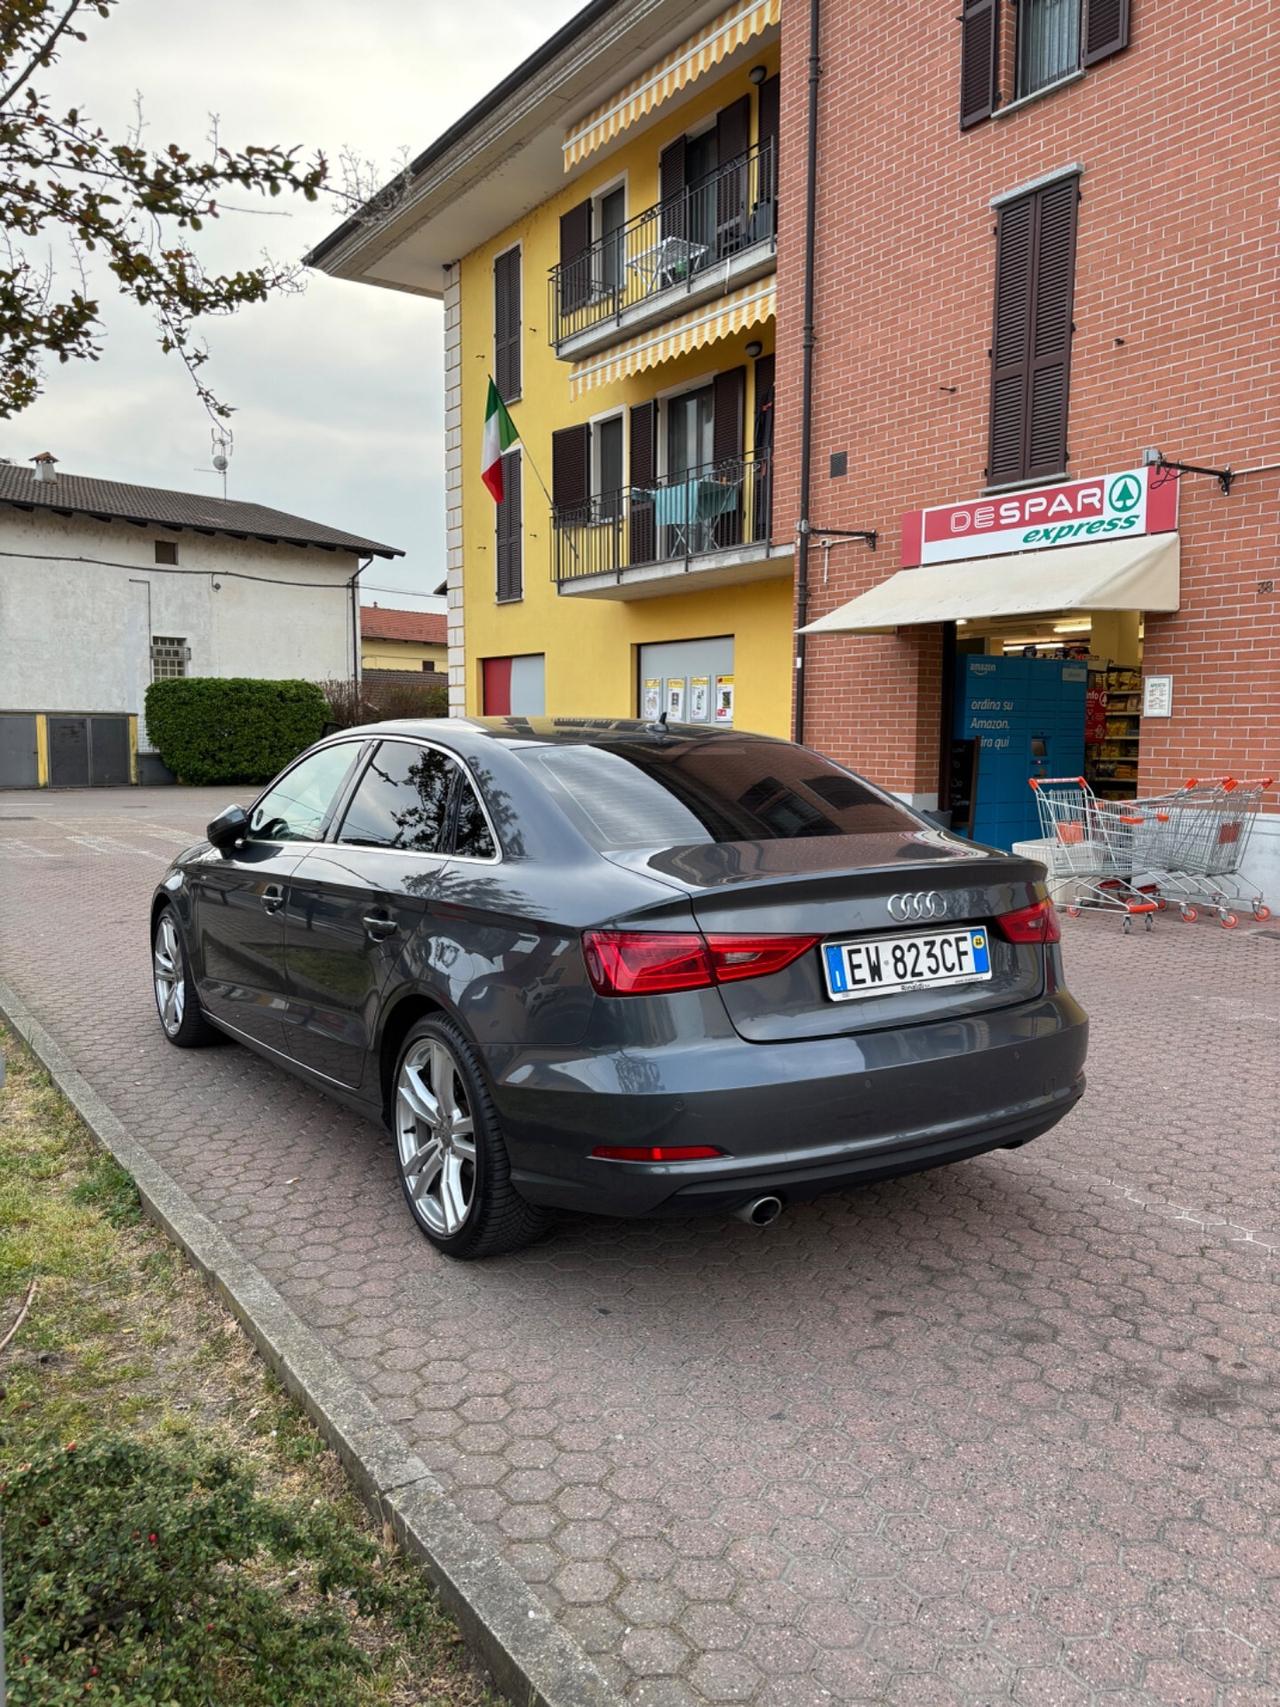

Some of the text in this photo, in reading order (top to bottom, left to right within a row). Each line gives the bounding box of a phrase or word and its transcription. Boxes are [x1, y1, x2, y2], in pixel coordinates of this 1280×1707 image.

[950, 487, 1102, 533] DESPAR
[1022, 514, 1140, 544] express
[970, 663, 997, 673] amazon
[971, 699, 1013, 710] ordina su
[994, 736, 1010, 748] qui
[847, 937, 968, 985] EW 823CF
